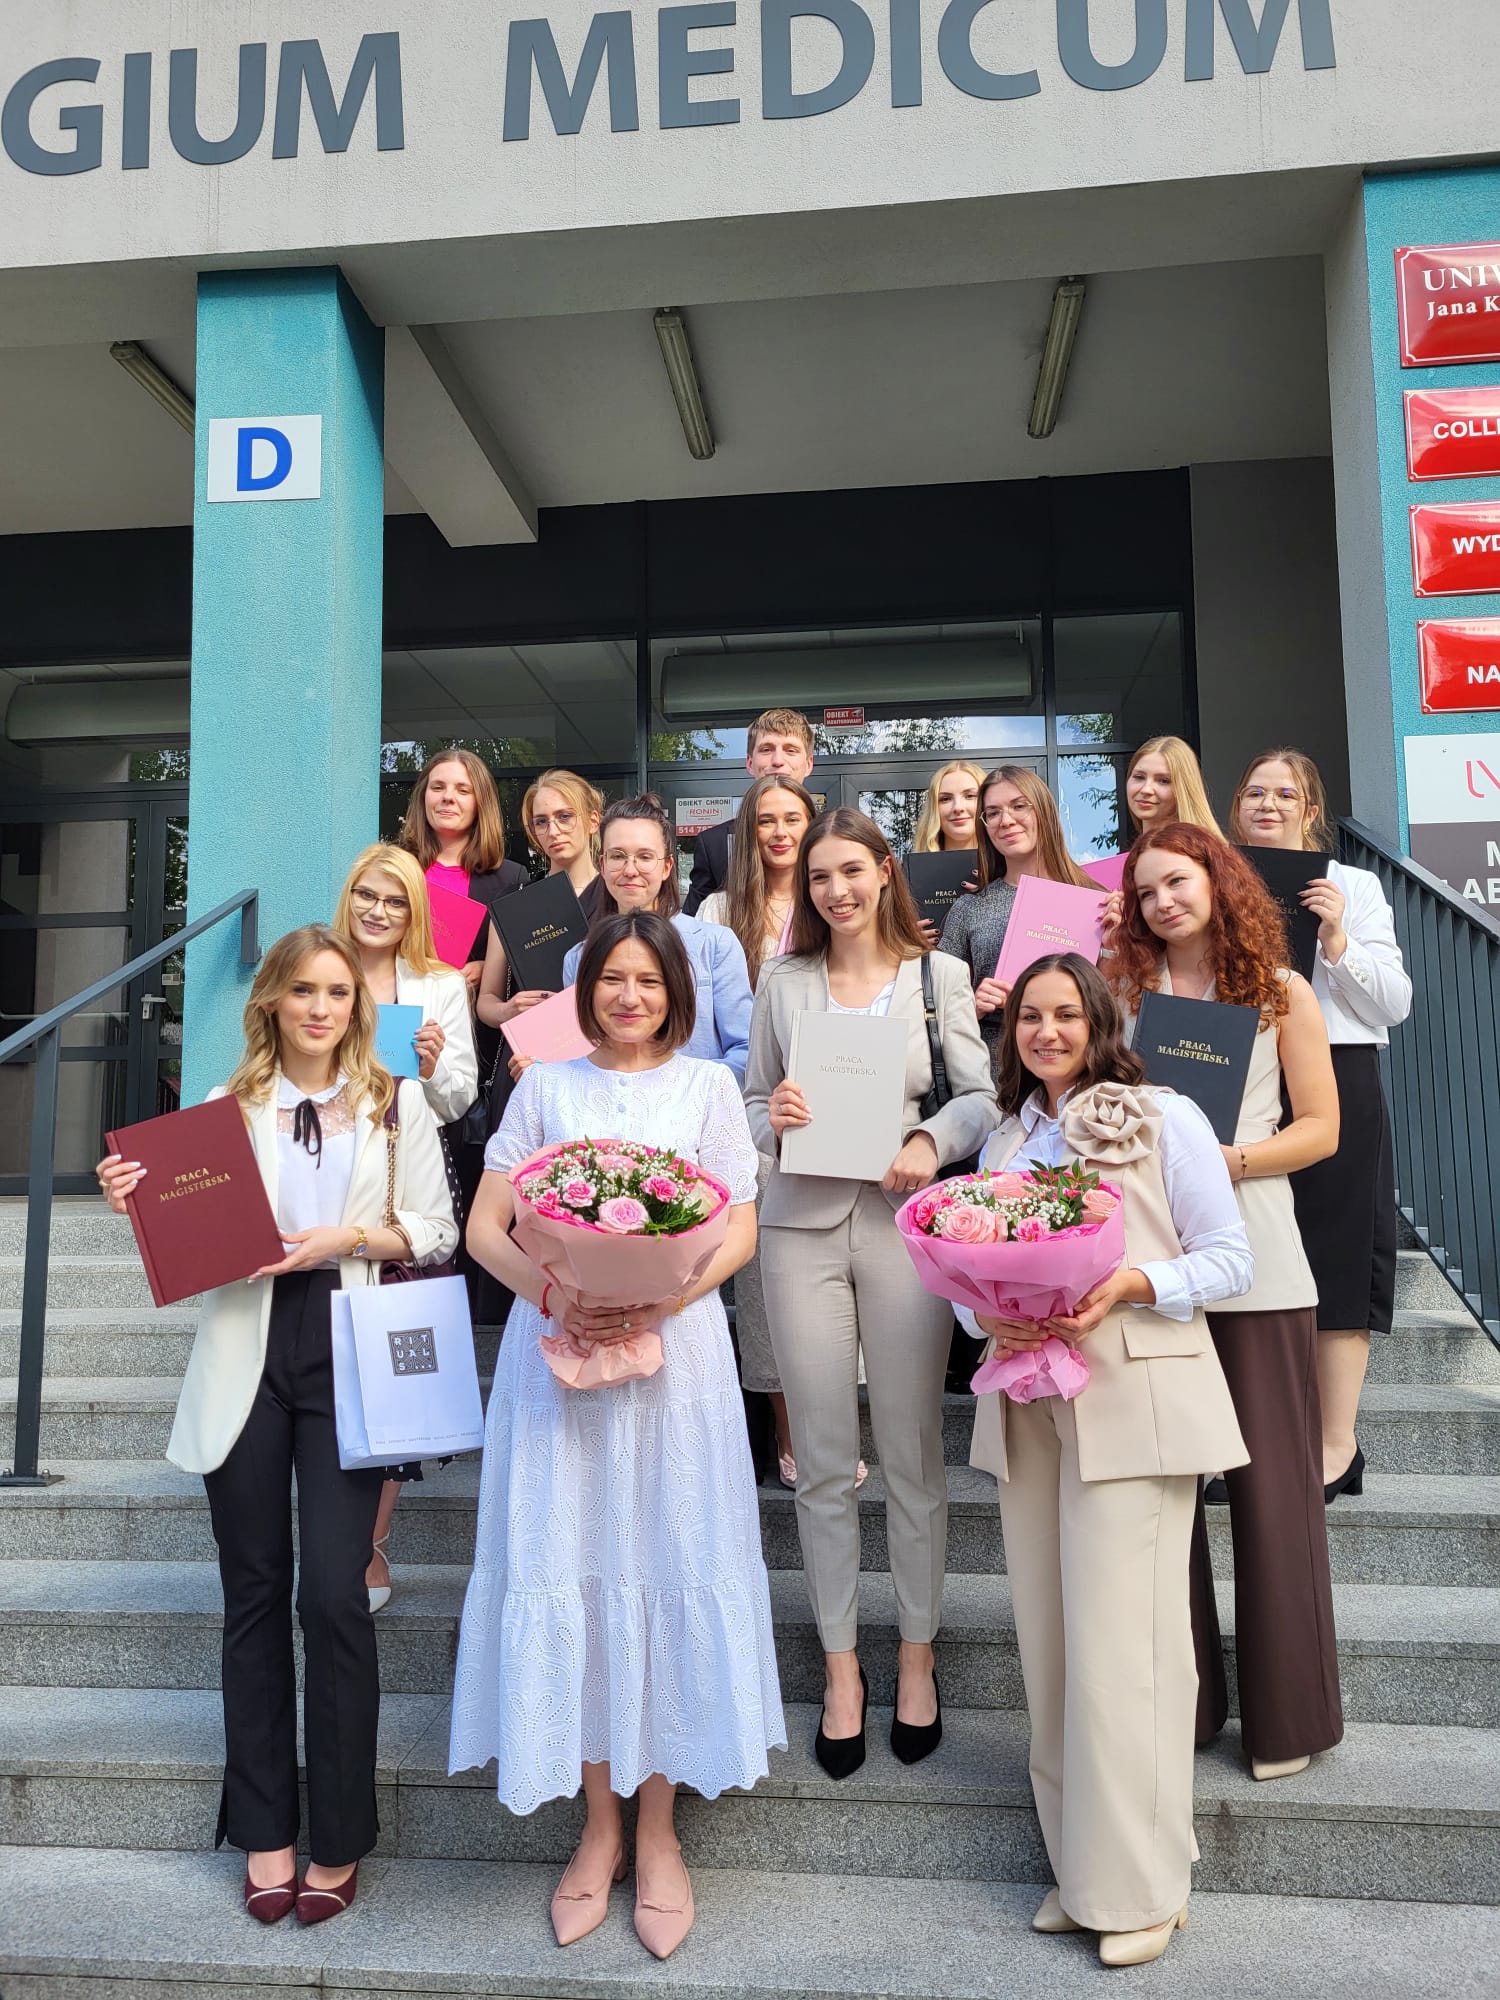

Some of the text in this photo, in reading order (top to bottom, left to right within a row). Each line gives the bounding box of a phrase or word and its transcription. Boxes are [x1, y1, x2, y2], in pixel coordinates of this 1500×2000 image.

[1, 0, 1336, 176] GIUM MEDICUM
[1427, 301, 1478, 321] Jana
[236, 427, 292, 491] D
[935, 889, 957, 897] PRACA
[524, 926, 569, 950] MAGISTERSKA
[532, 923, 554, 938] PRACA
[1026, 929, 1080, 949] MAGISTERSKA
[1042, 923, 1068, 936] PRACA
[1157, 1045, 1230, 1066] MAGISTERSKA
[1178, 1039, 1212, 1053] PRACA
[835, 1055, 863, 1064] PRACA
[819, 1064, 877, 1076] MAGISTERSKA
[174, 1167, 210, 1185] PRACA
[159, 1172, 231, 1203] MAGISTERSKA
